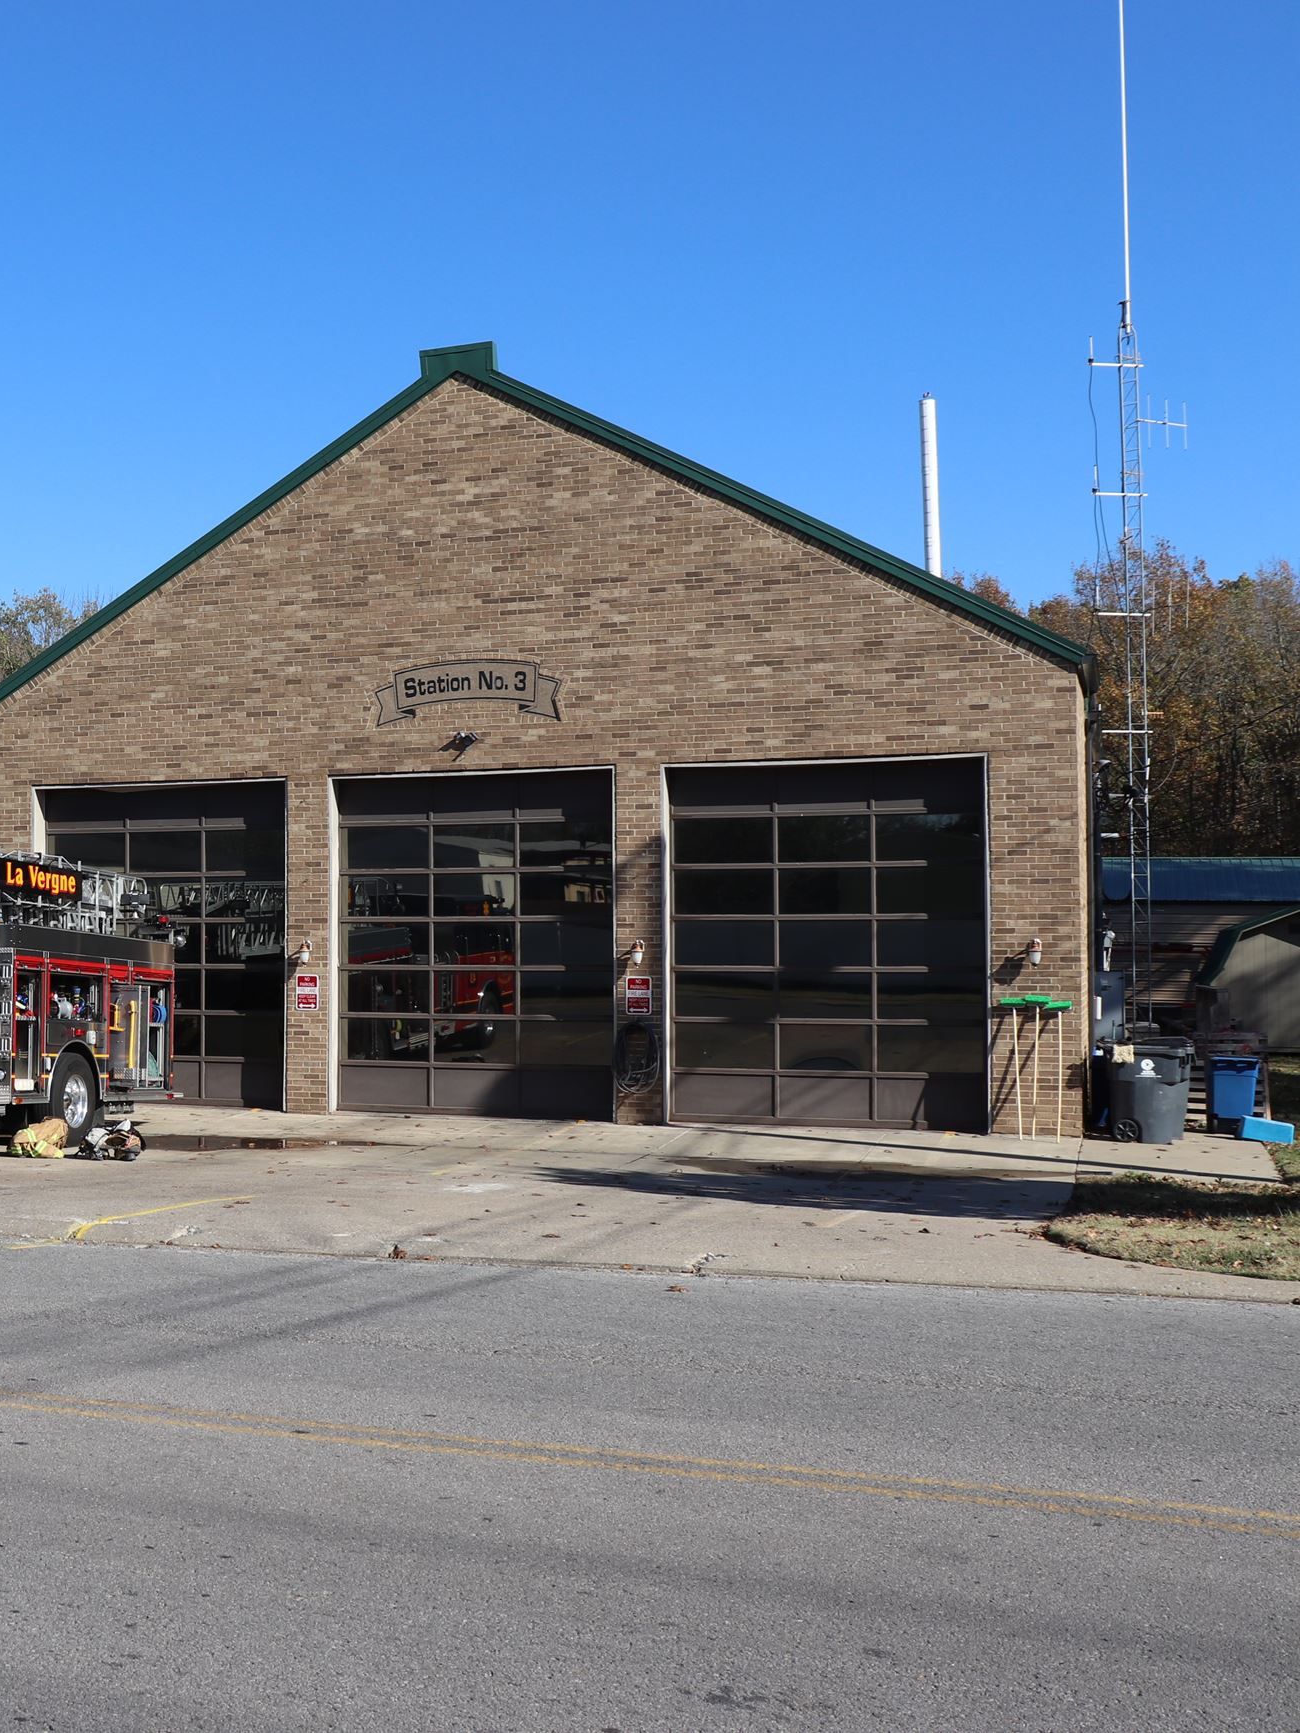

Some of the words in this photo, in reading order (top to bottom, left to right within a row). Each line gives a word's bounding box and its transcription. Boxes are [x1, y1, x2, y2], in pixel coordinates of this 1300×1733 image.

[404, 673, 471, 698] Station
[479, 671, 508, 691] No.
[514, 671, 527, 692] 3
[6, 861, 24, 886] La
[28, 865, 77, 895] Vergne
